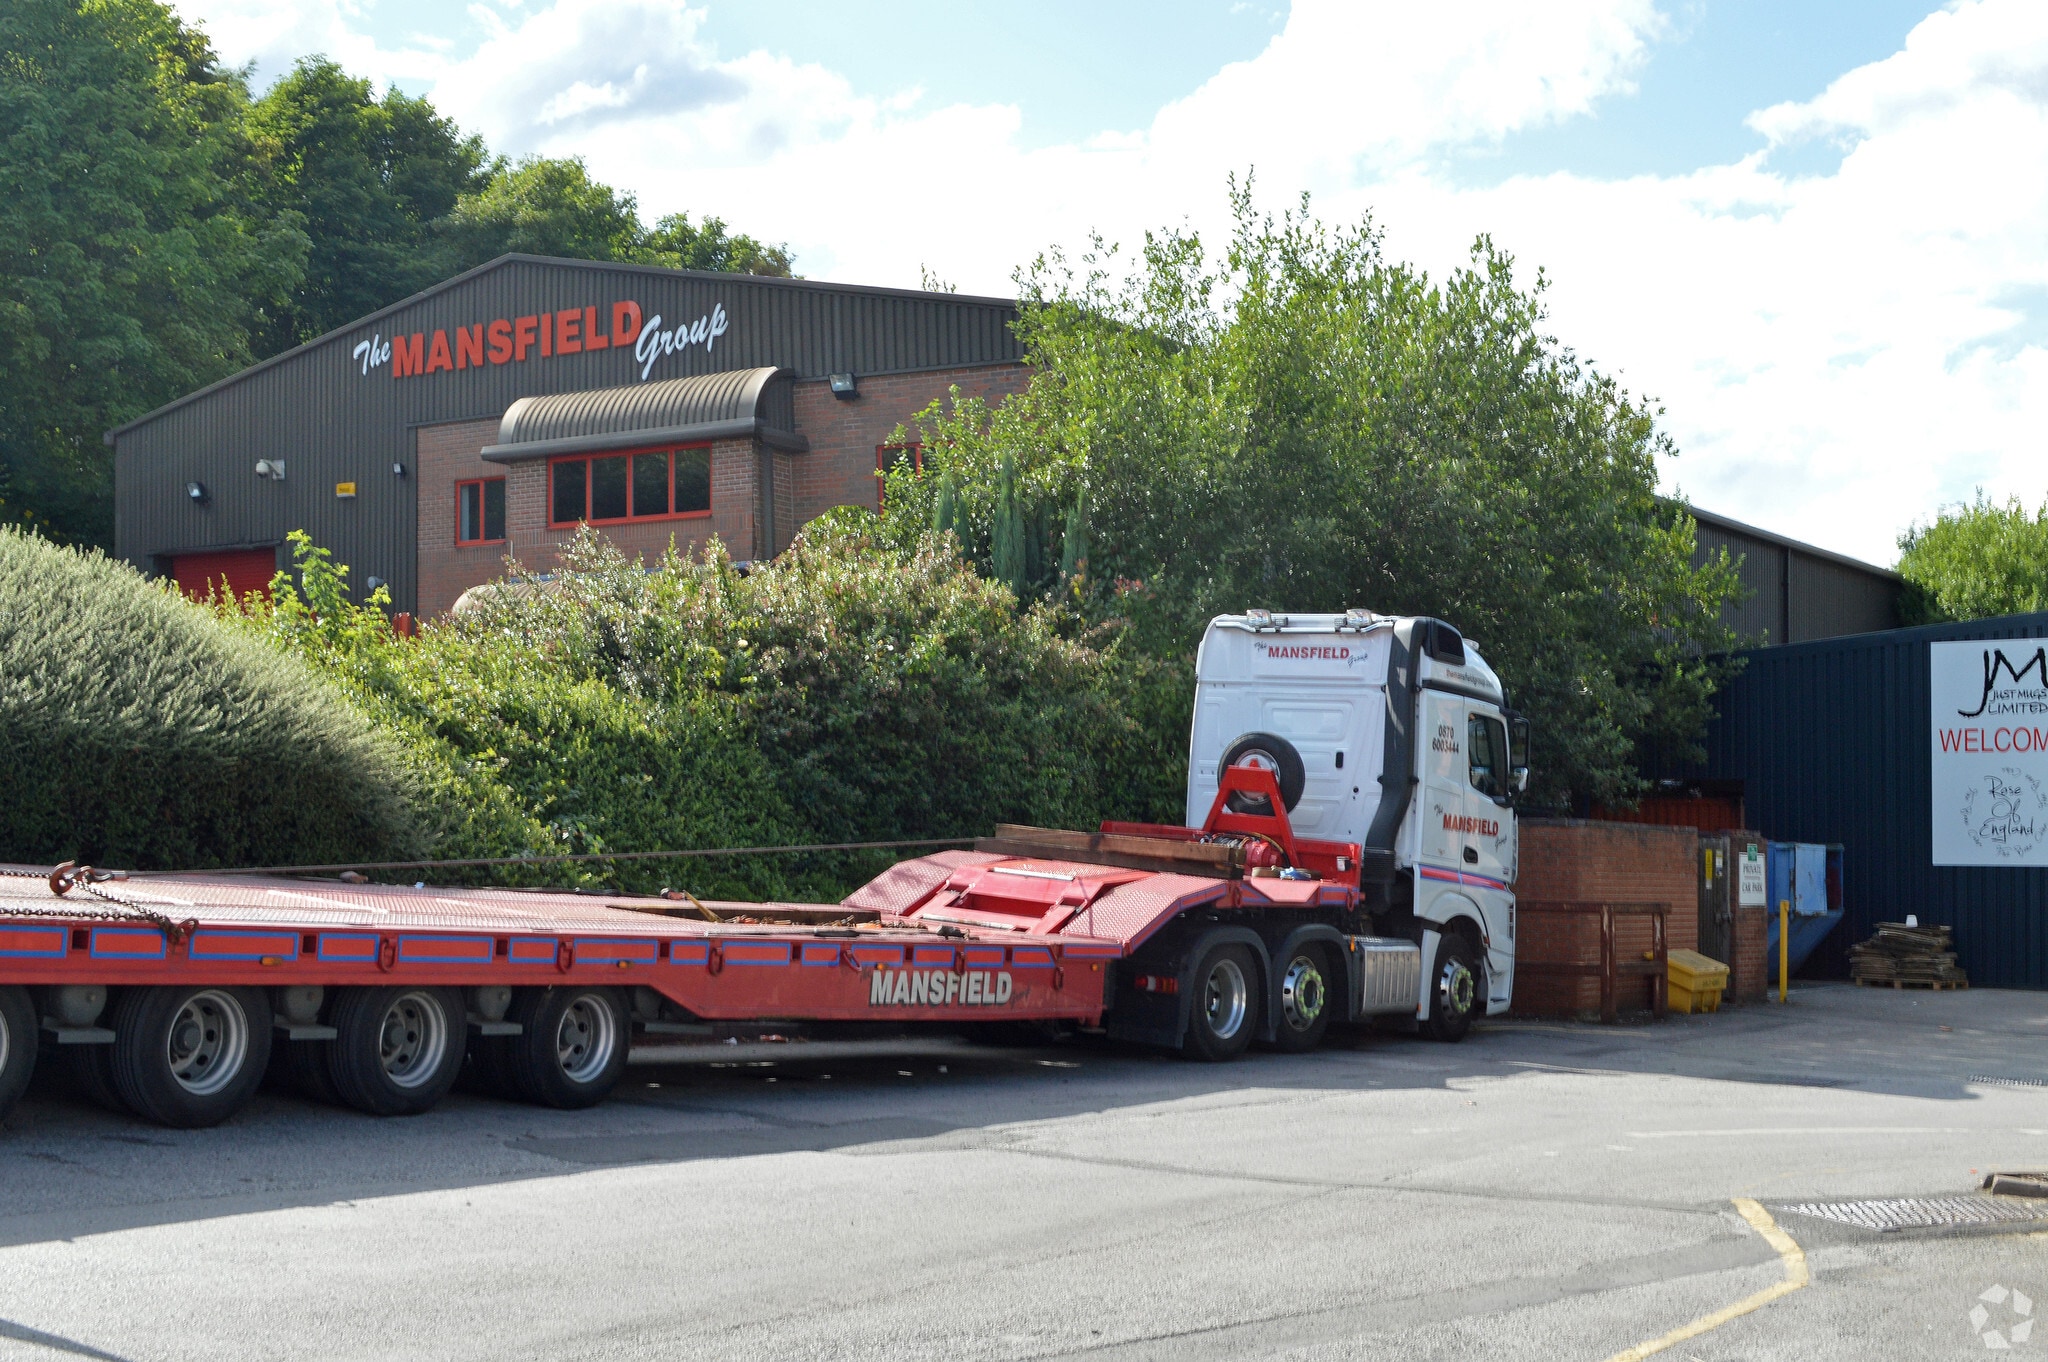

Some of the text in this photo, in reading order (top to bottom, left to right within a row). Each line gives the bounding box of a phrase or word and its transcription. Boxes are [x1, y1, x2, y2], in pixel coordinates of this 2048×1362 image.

[353, 299, 729, 382] The MANSFIELD Group
[1268, 646, 1350, 660] MANSFIELD
[1989, 688, 2048, 703] JUST MUGS
[1988, 701, 2048, 716] LIMITED
[1983, 775, 2021, 799] Rose
[1443, 813, 1499, 837] MANSFIELD
[1979, 816, 2034, 844] England
[870, 969, 1012, 1007] MANSFIELD
